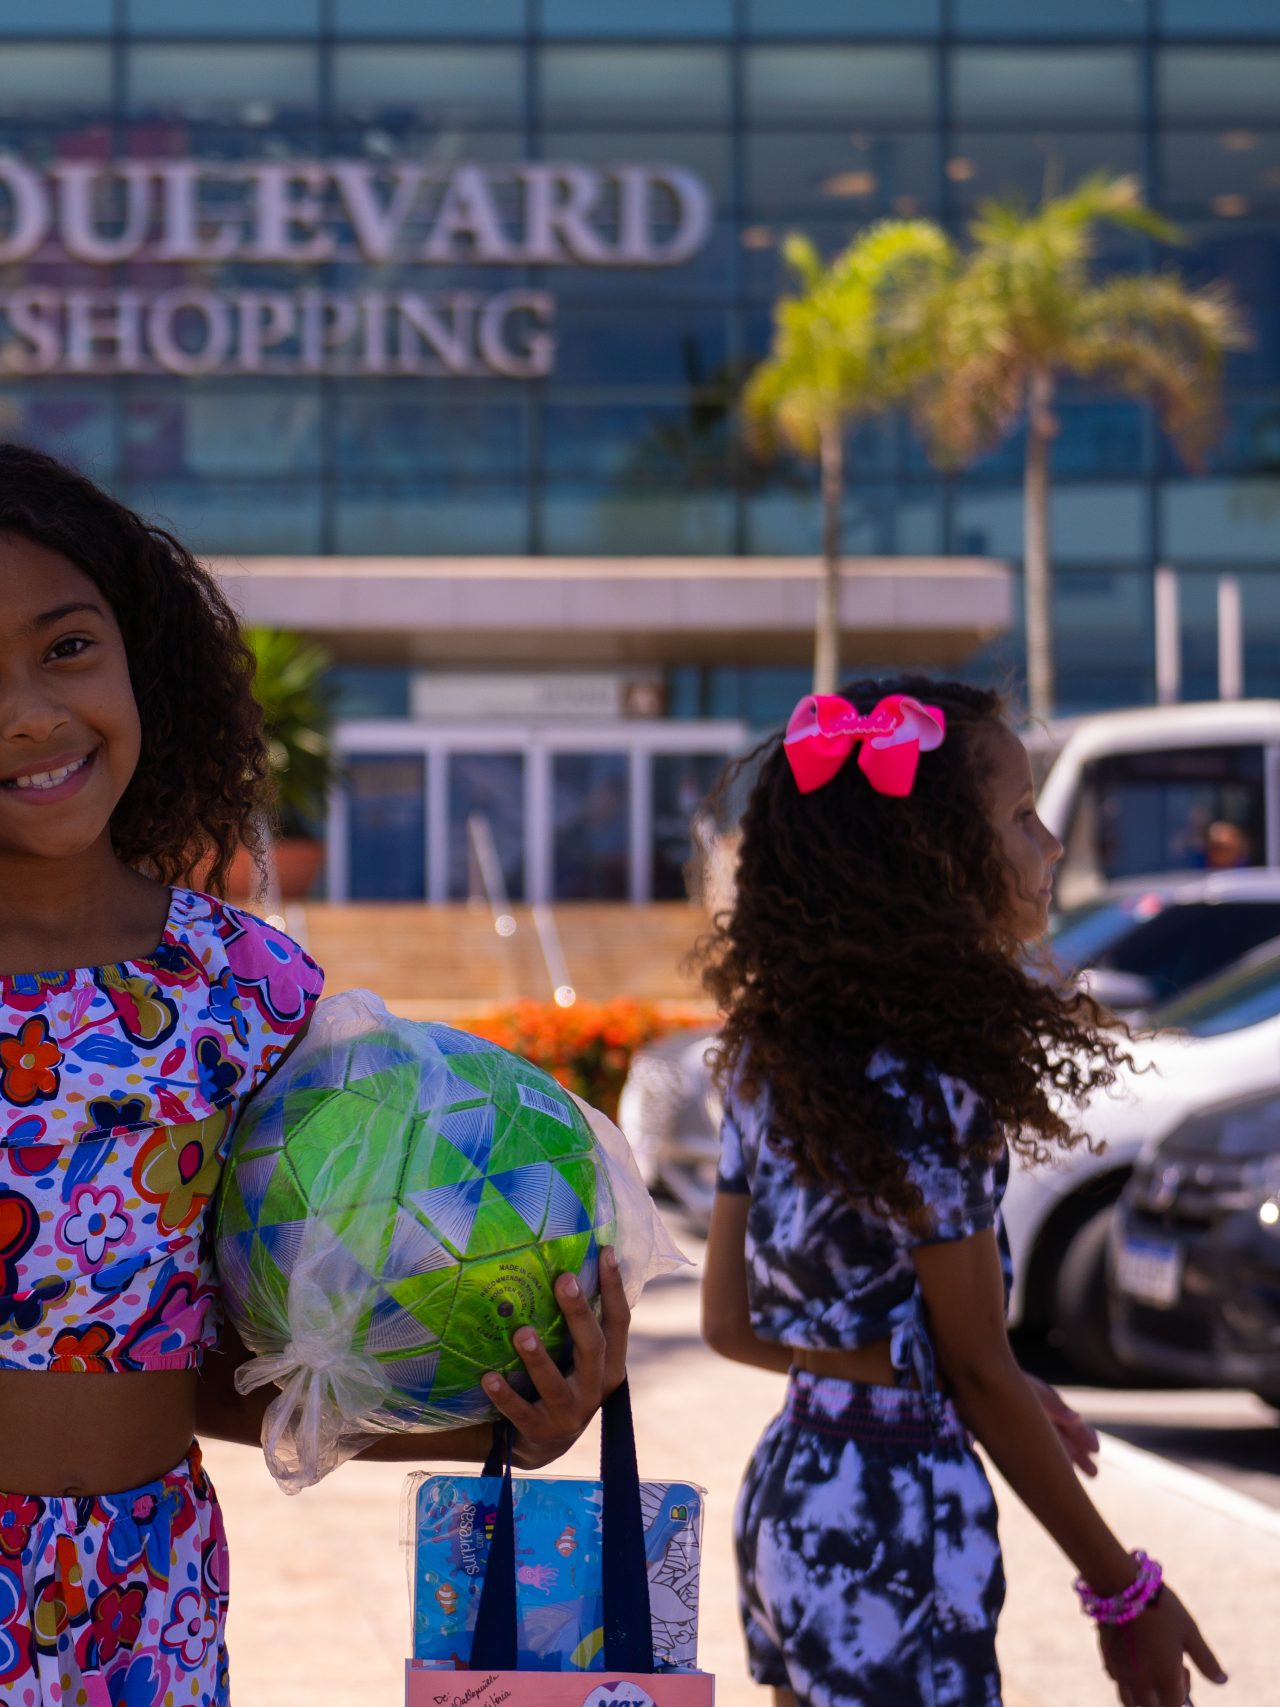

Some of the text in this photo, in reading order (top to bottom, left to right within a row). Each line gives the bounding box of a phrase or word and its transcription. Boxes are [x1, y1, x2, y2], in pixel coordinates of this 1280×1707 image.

[3, 287, 557, 377] SHOPPING
[499, 1264, 542, 1290] MADE IN CHINA
[459, 1504, 480, 1575] surpresas
